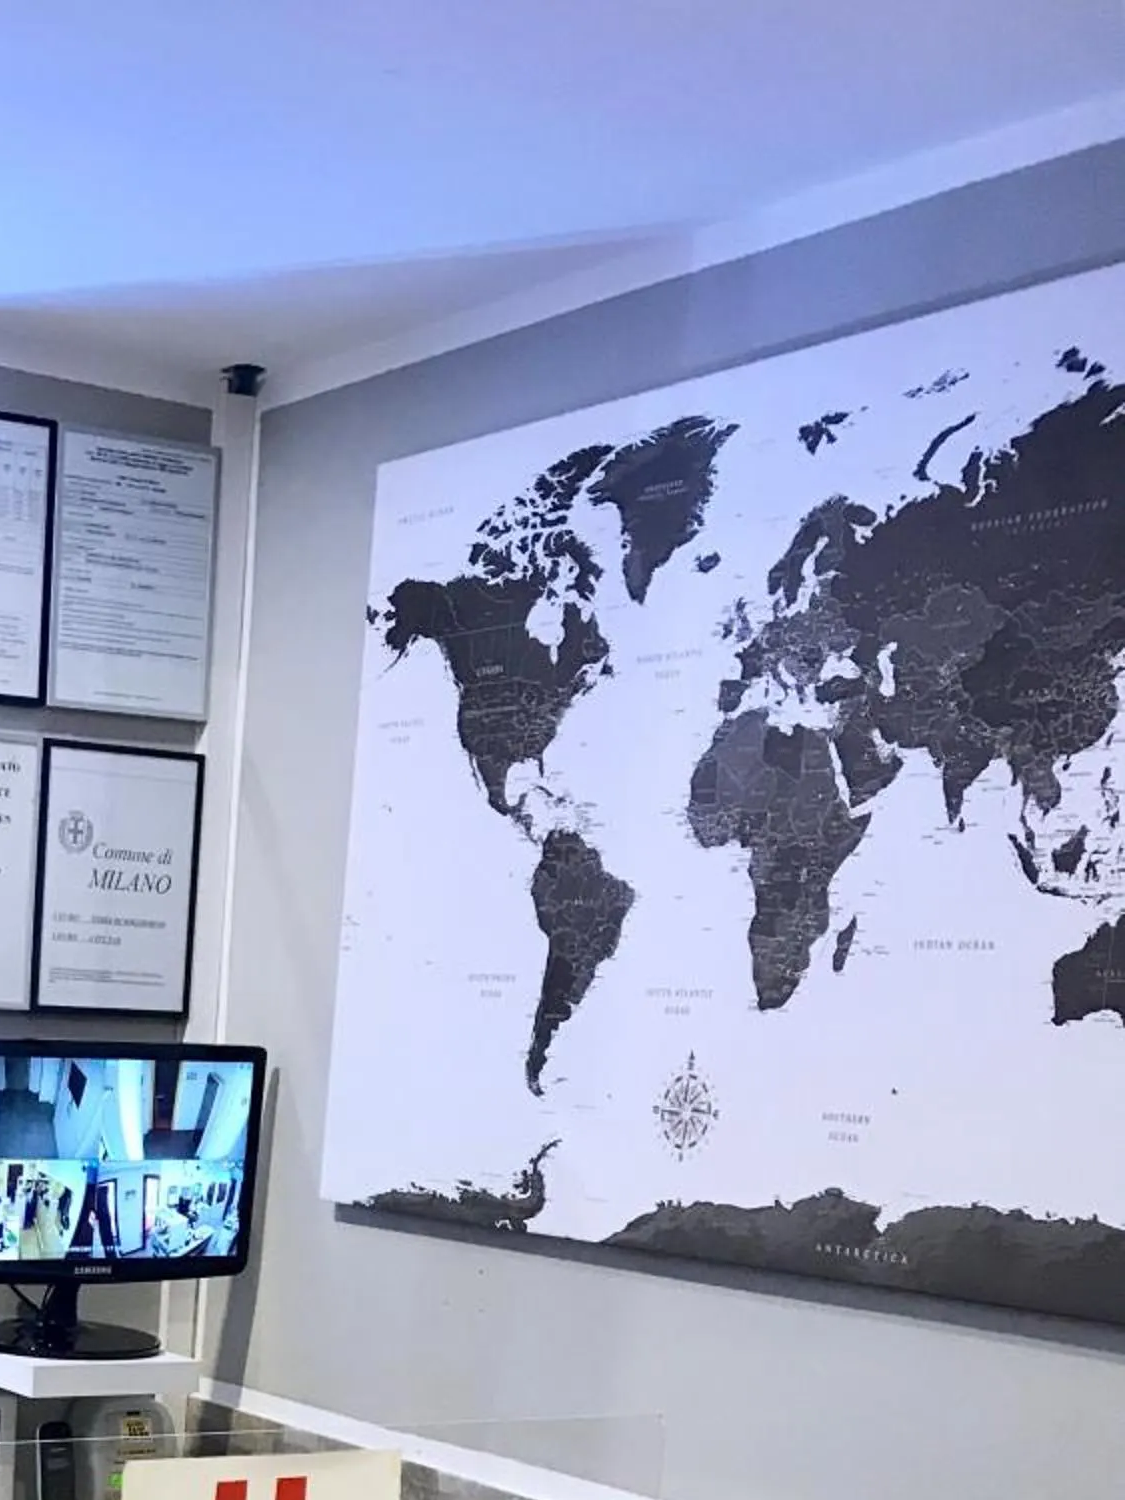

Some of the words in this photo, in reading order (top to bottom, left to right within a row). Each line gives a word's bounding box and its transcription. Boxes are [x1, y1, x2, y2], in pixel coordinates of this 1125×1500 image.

[92, 841, 156, 865] Comune
[157, 848, 174, 866] di
[88, 868, 173, 895] MILANO
[815, 1243, 909, 1265] ANTARCTICA
